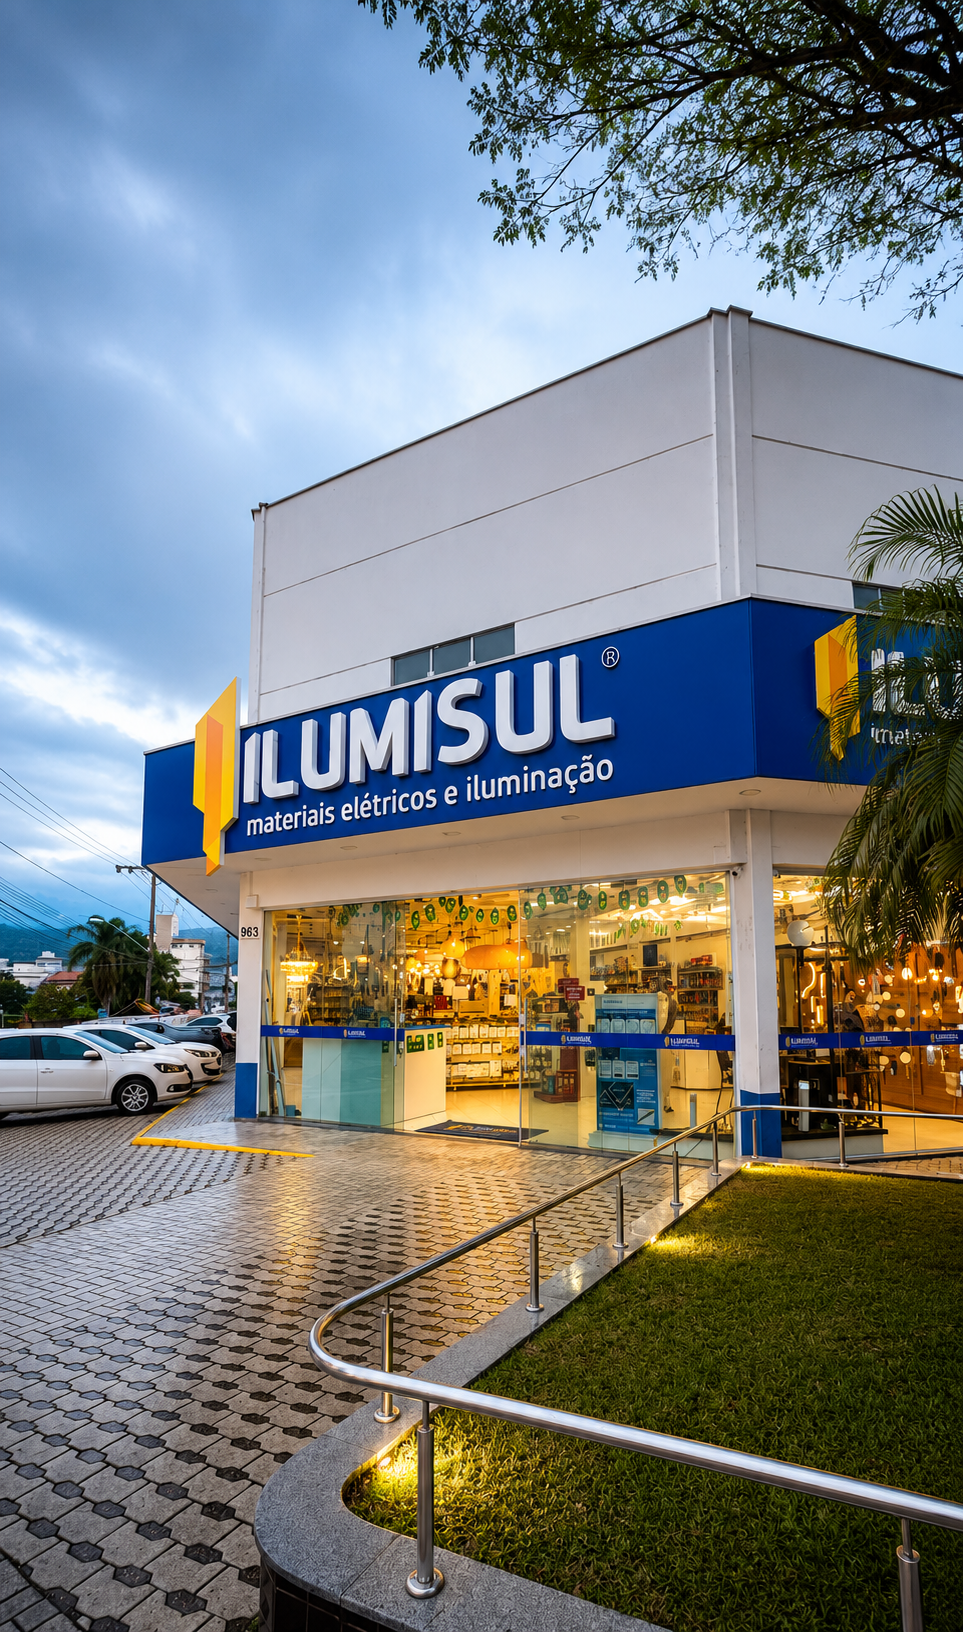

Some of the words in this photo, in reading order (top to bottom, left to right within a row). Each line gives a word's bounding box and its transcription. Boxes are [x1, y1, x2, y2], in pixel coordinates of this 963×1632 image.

[243, 654, 616, 804] ILUMISUL
[247, 802, 335, 837] materiais
[341, 788, 438, 821] elétricos
[444, 785, 459, 805] e
[466, 754, 614, 802] iluminação
[240, 926, 259, 938] 963
